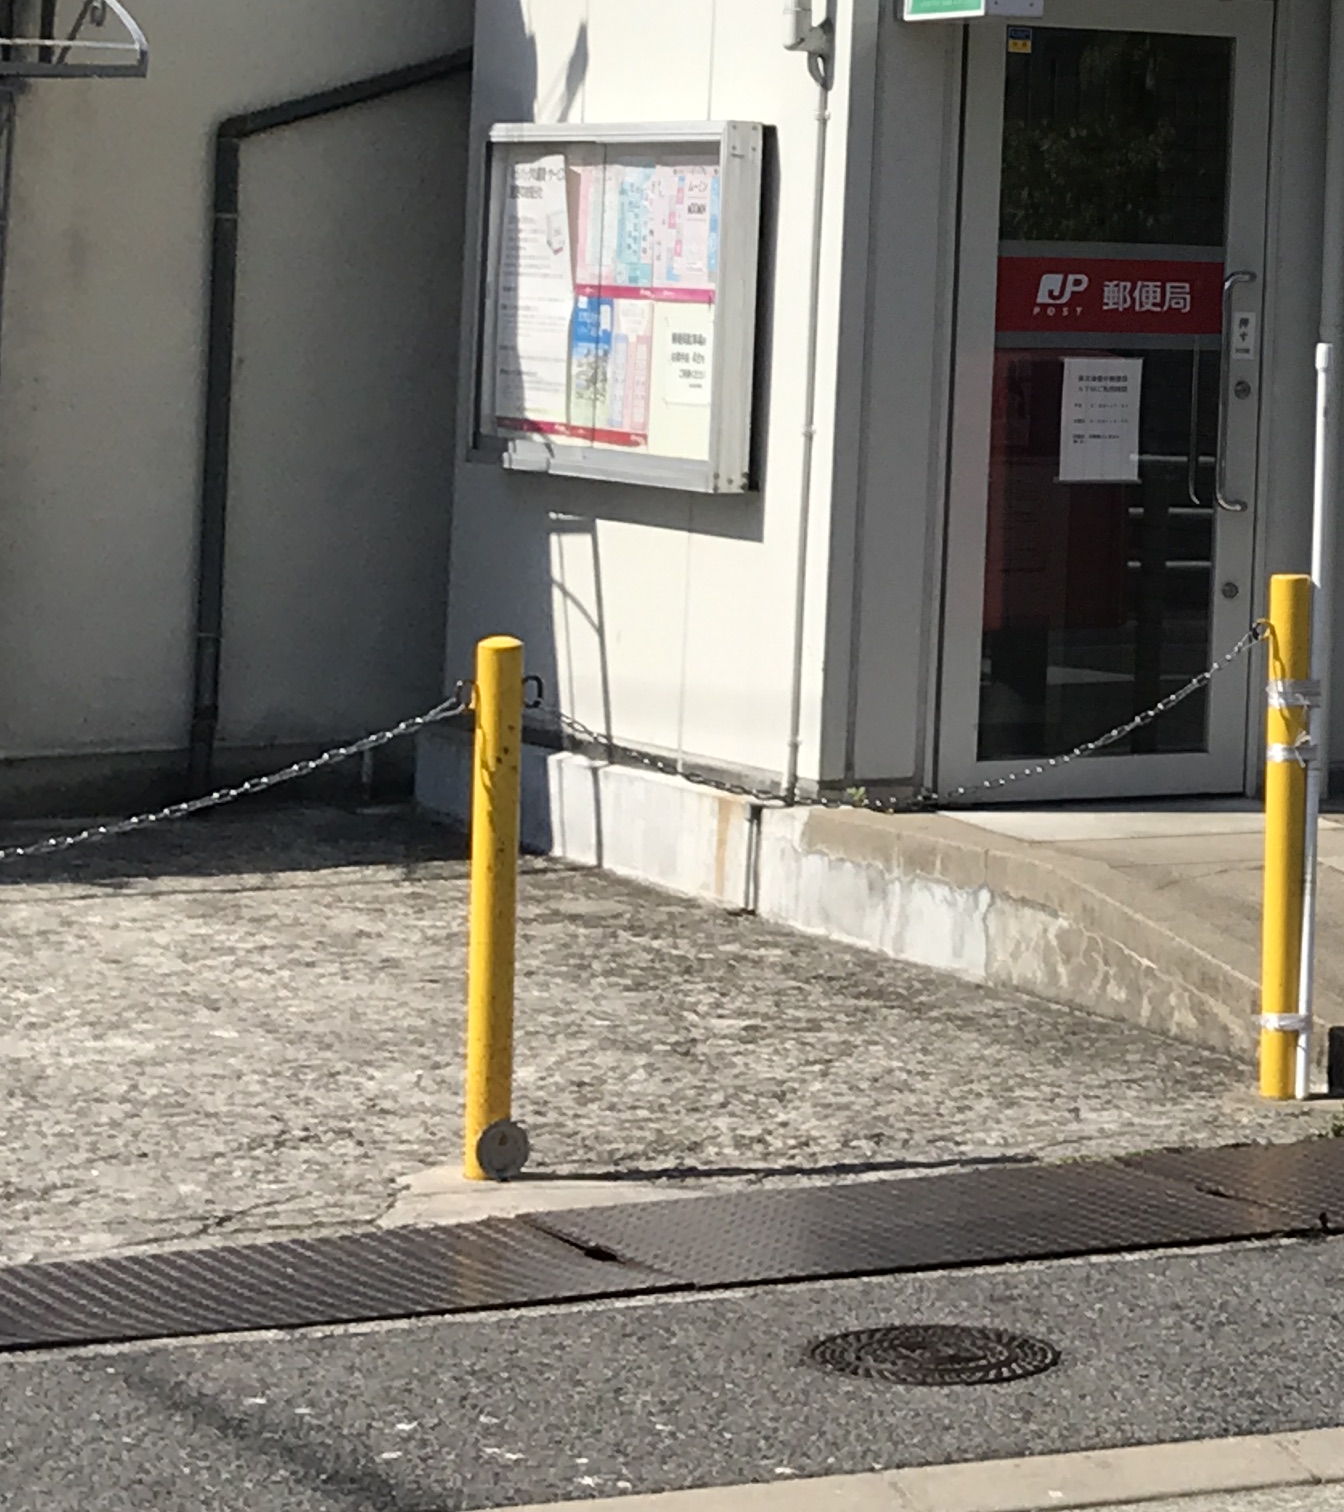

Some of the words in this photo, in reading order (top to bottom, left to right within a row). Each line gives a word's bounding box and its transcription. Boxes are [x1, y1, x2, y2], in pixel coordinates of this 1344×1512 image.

[1103, 281, 1191, 313] 郵便局
[1033, 307, 1083, 317] POST
